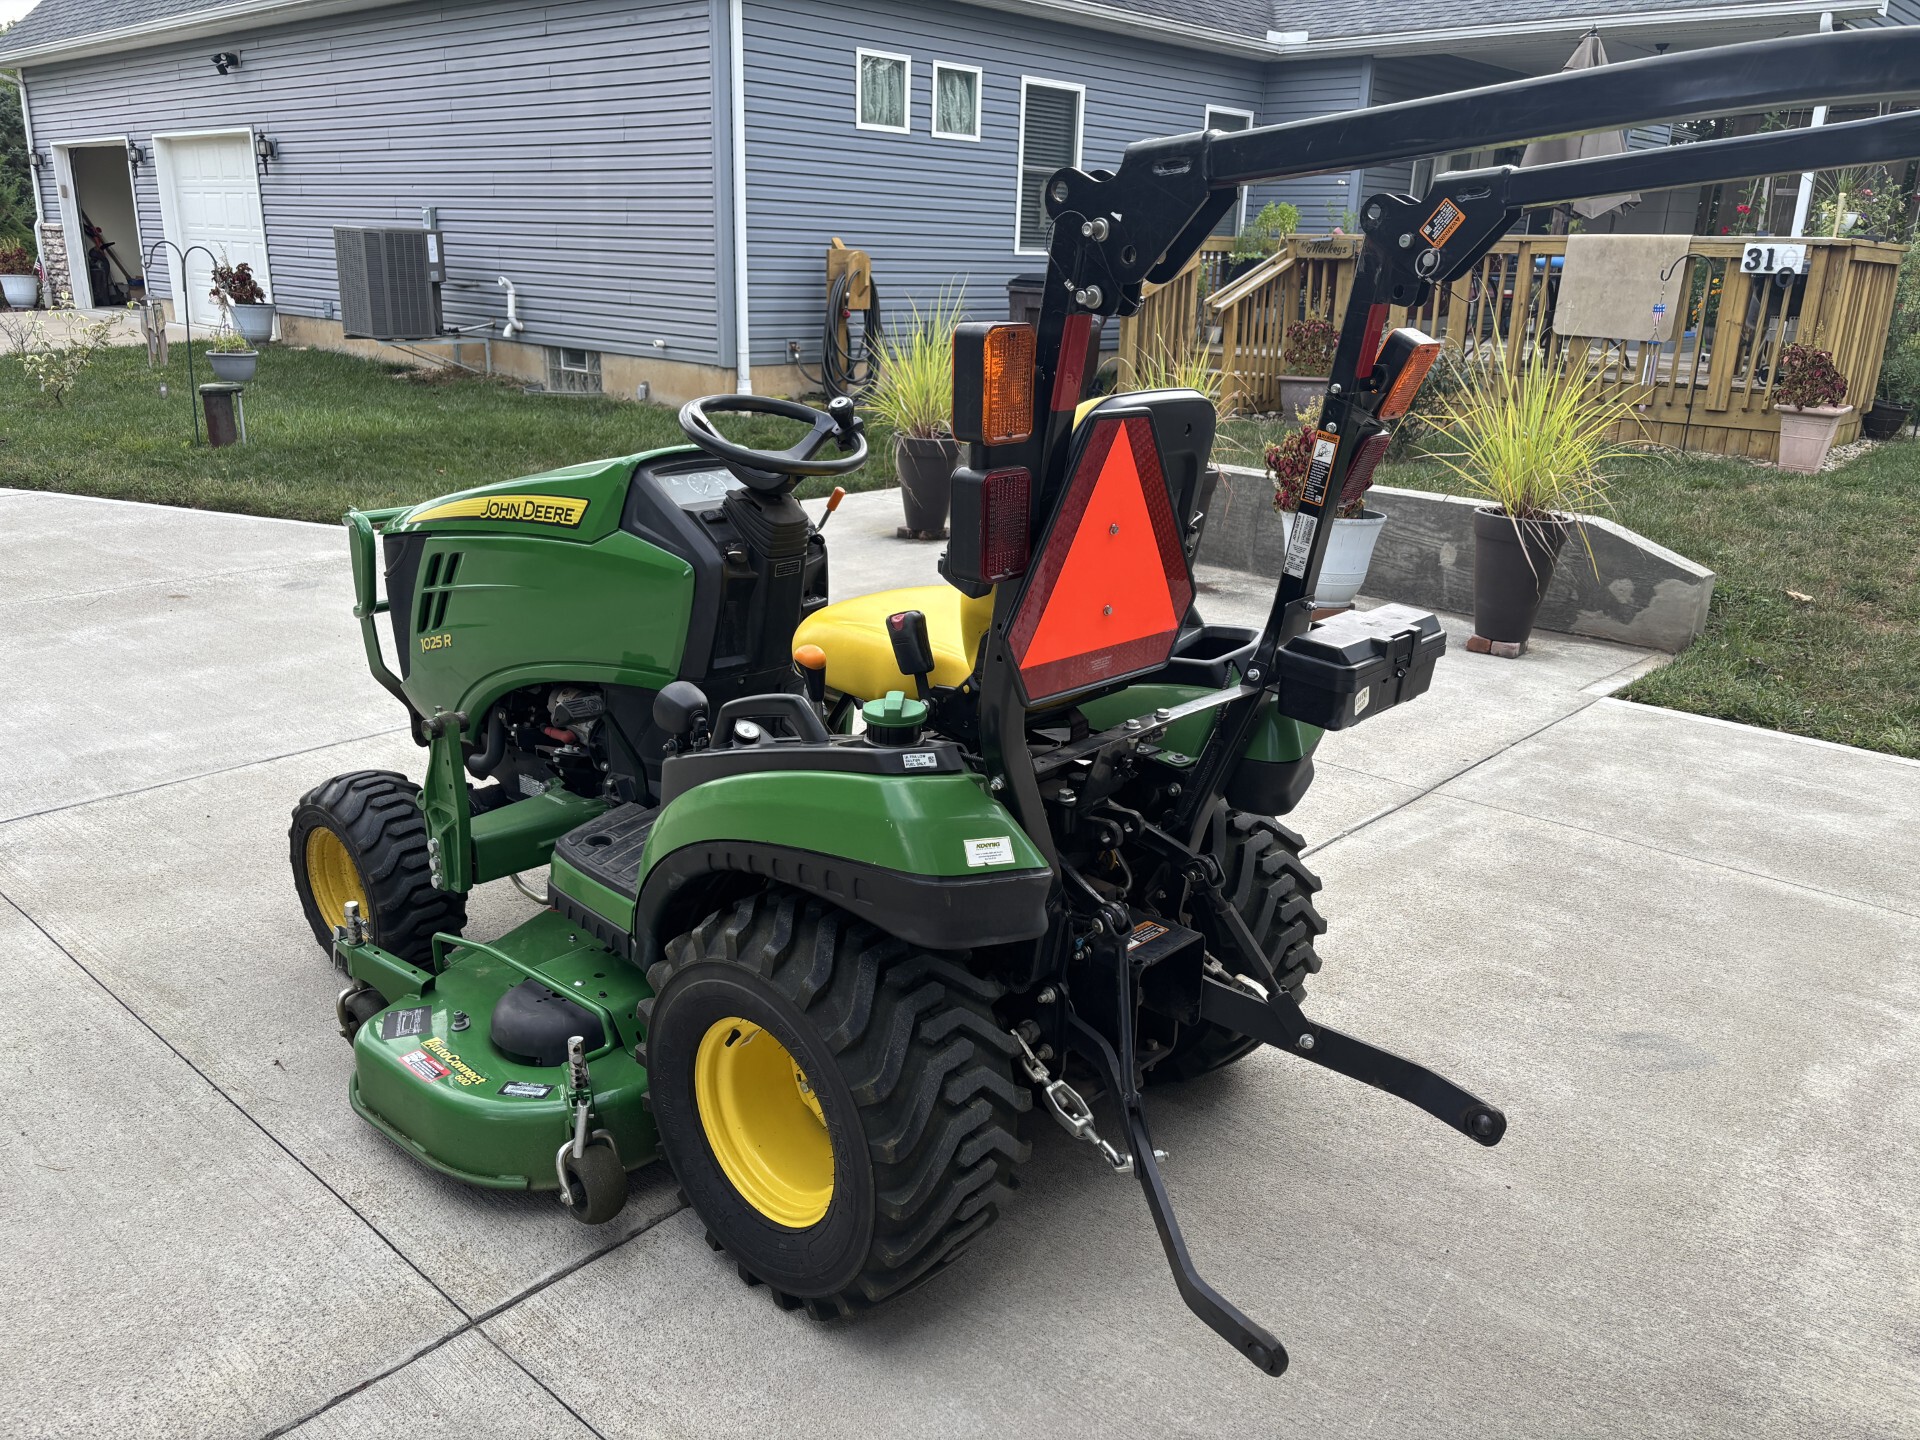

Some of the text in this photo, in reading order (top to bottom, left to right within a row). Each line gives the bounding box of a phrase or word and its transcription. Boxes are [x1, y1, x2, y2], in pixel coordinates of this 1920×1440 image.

[1435, 221, 1459, 246] WARNING
[480, 499, 575, 523] JOHN DEERE
[421, 1037, 487, 1085] AutoConnect
[454, 1074, 472, 1086] 60D
